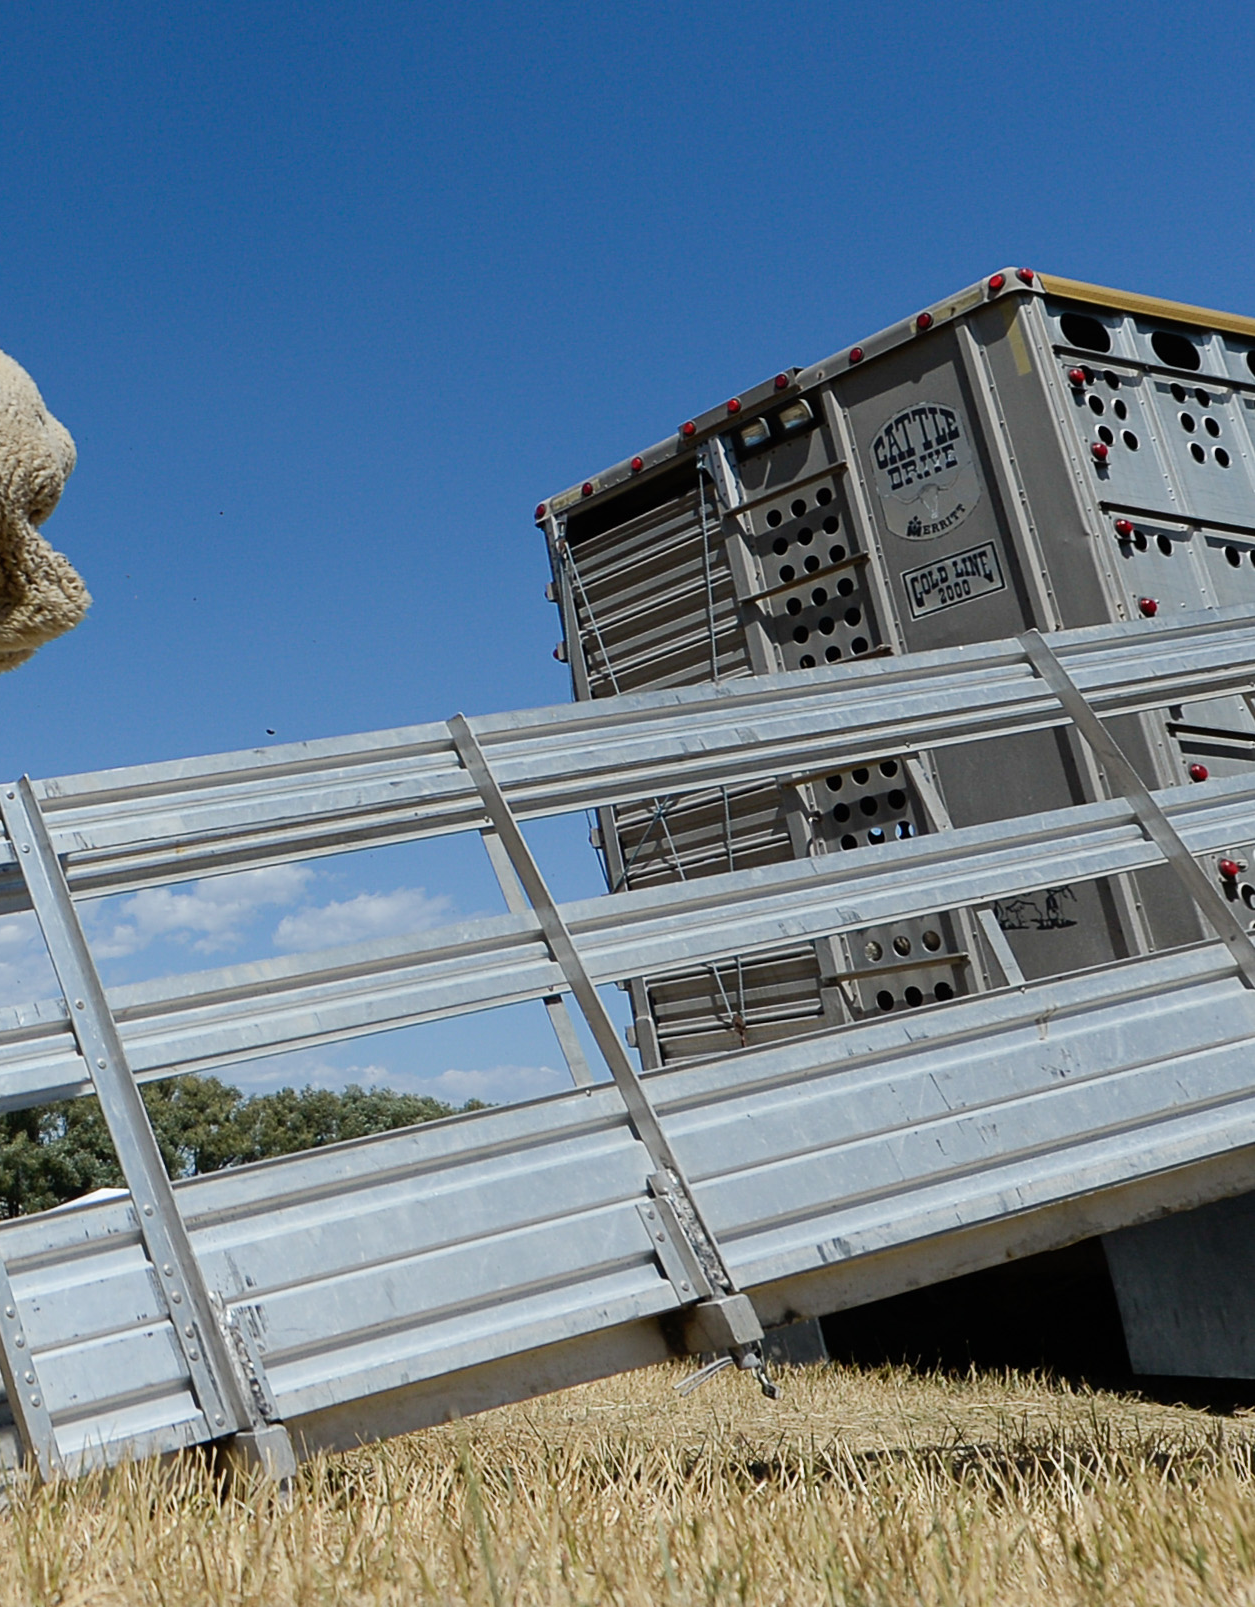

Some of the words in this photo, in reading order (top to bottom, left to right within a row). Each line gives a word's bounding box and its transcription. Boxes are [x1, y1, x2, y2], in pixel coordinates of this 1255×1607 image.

[873, 407, 960, 470] CATTLE
[887, 443, 958, 490] DRIVE
[910, 566, 949, 608] GOLD
[952, 550, 994, 583] LINE
[938, 579, 971, 604] 2000
